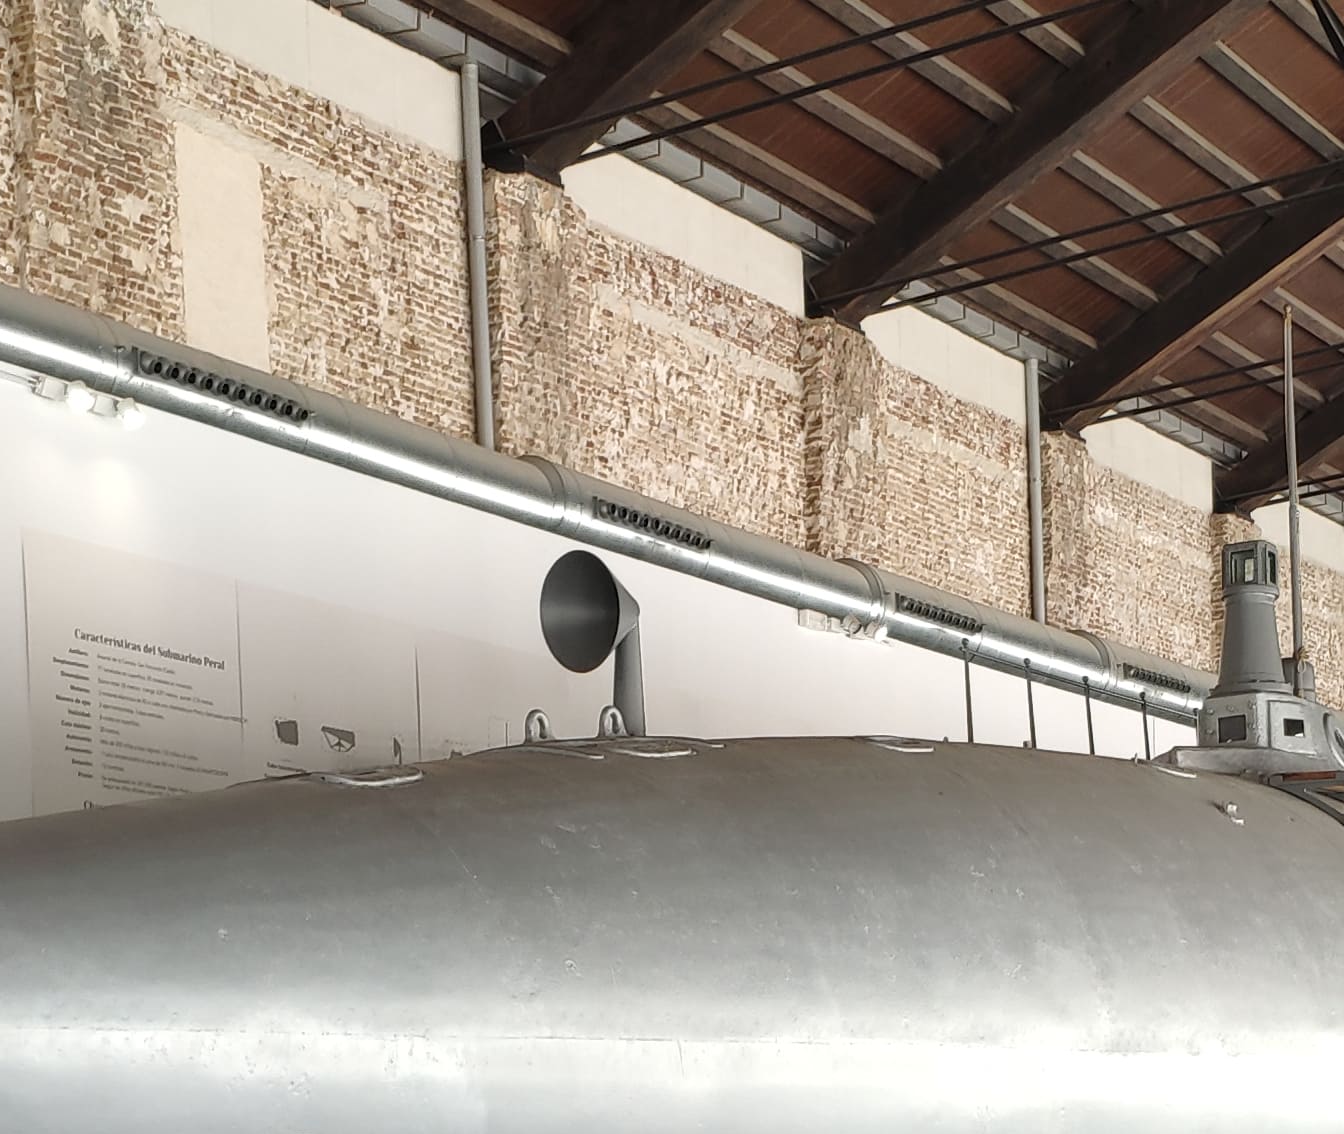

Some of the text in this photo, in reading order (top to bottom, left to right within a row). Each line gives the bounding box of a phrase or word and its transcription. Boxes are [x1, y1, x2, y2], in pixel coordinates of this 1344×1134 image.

[143, 643, 156, 656] del
[157, 646, 203, 667] Submarino
[203, 656, 225, 671] Peral
